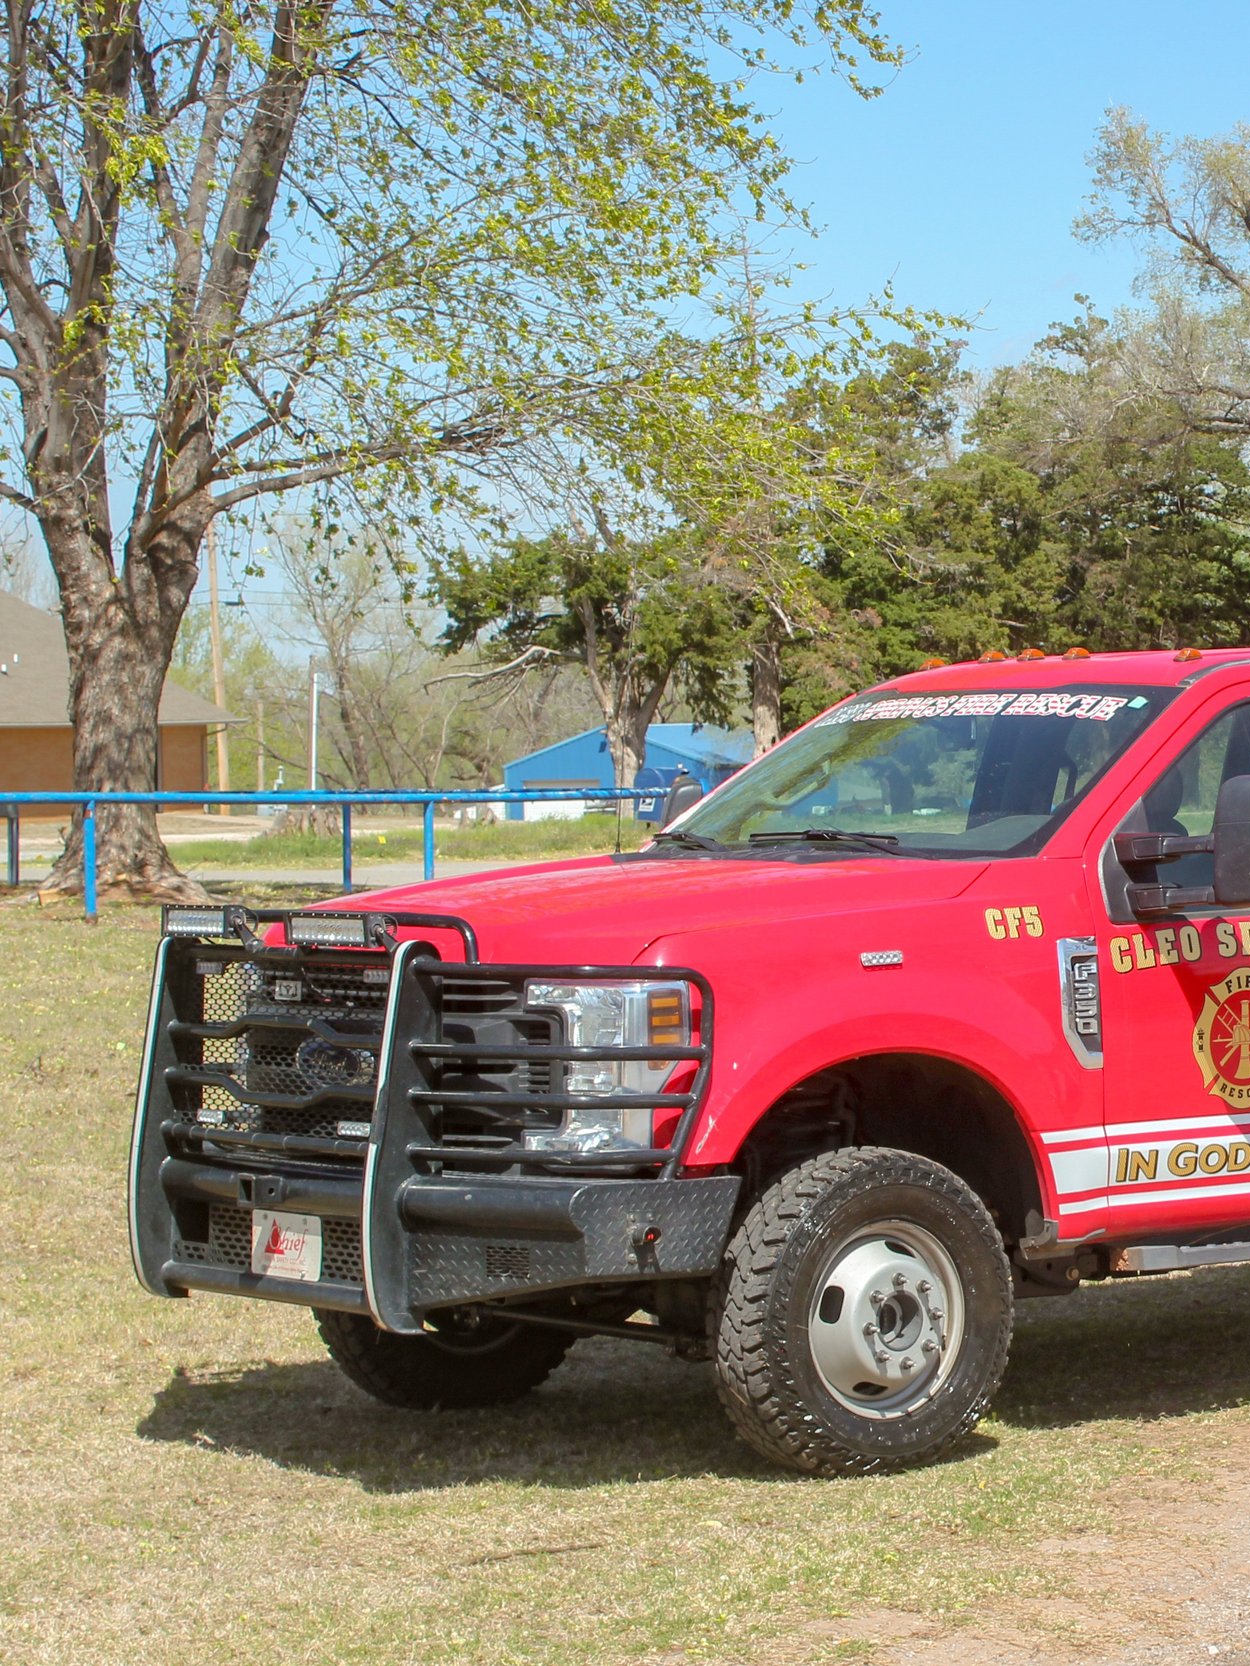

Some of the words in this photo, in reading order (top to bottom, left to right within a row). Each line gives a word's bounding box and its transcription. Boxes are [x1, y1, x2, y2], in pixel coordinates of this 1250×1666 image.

[941, 694, 1017, 717] FIRE
[1000, 694, 1128, 721] RESCUE
[984, 905, 1044, 940] CF5
[1109, 925, 1202, 973] CLEO
[270, 1226, 308, 1261] Chief
